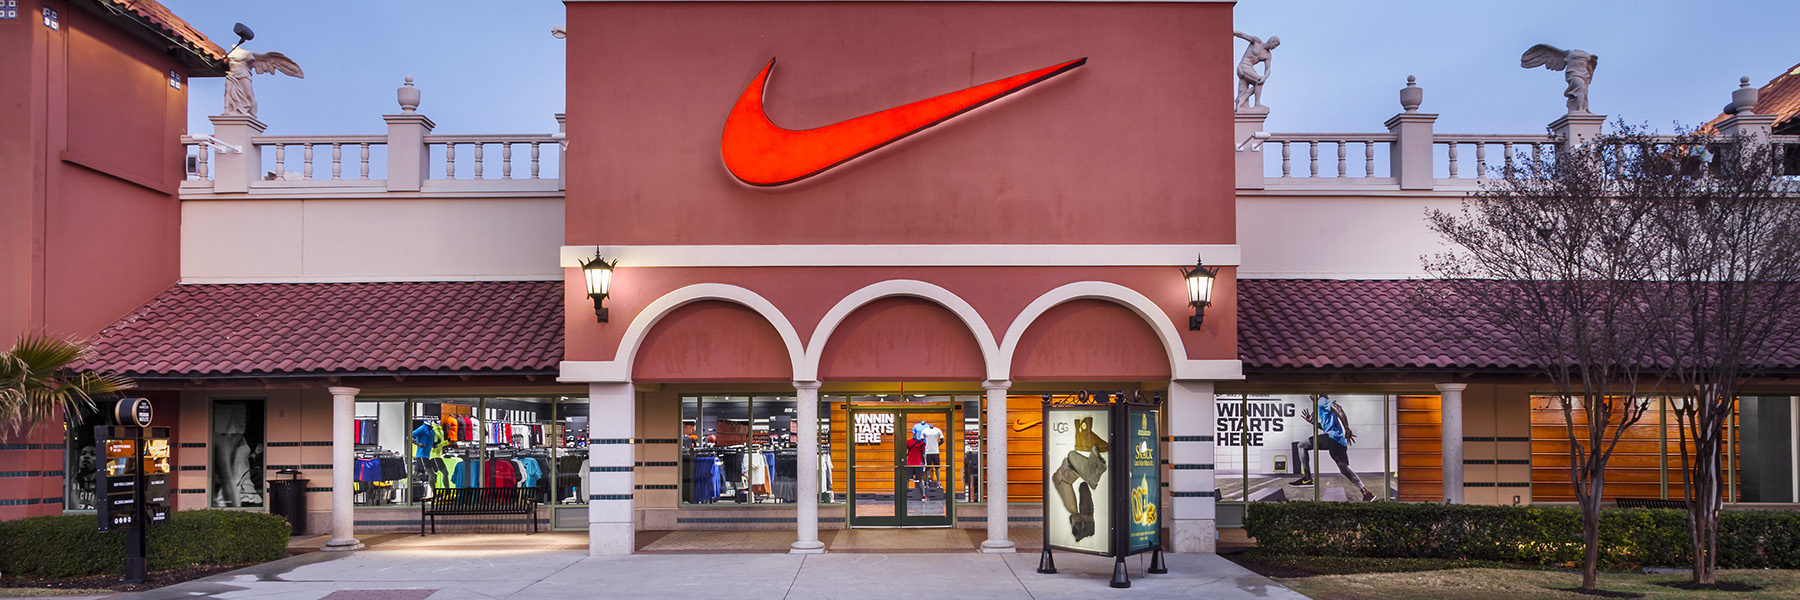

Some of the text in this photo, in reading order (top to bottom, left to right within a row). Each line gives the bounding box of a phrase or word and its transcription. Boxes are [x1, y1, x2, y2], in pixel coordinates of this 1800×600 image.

[1216, 403, 1295, 417] WINNING
[854, 413, 895, 424] WINNIN
[1216, 418, 1284, 432] STARTS
[1053, 422, 1069, 434] UGG
[854, 433, 882, 443] ERE
[1216, 432, 1264, 446] HERE
